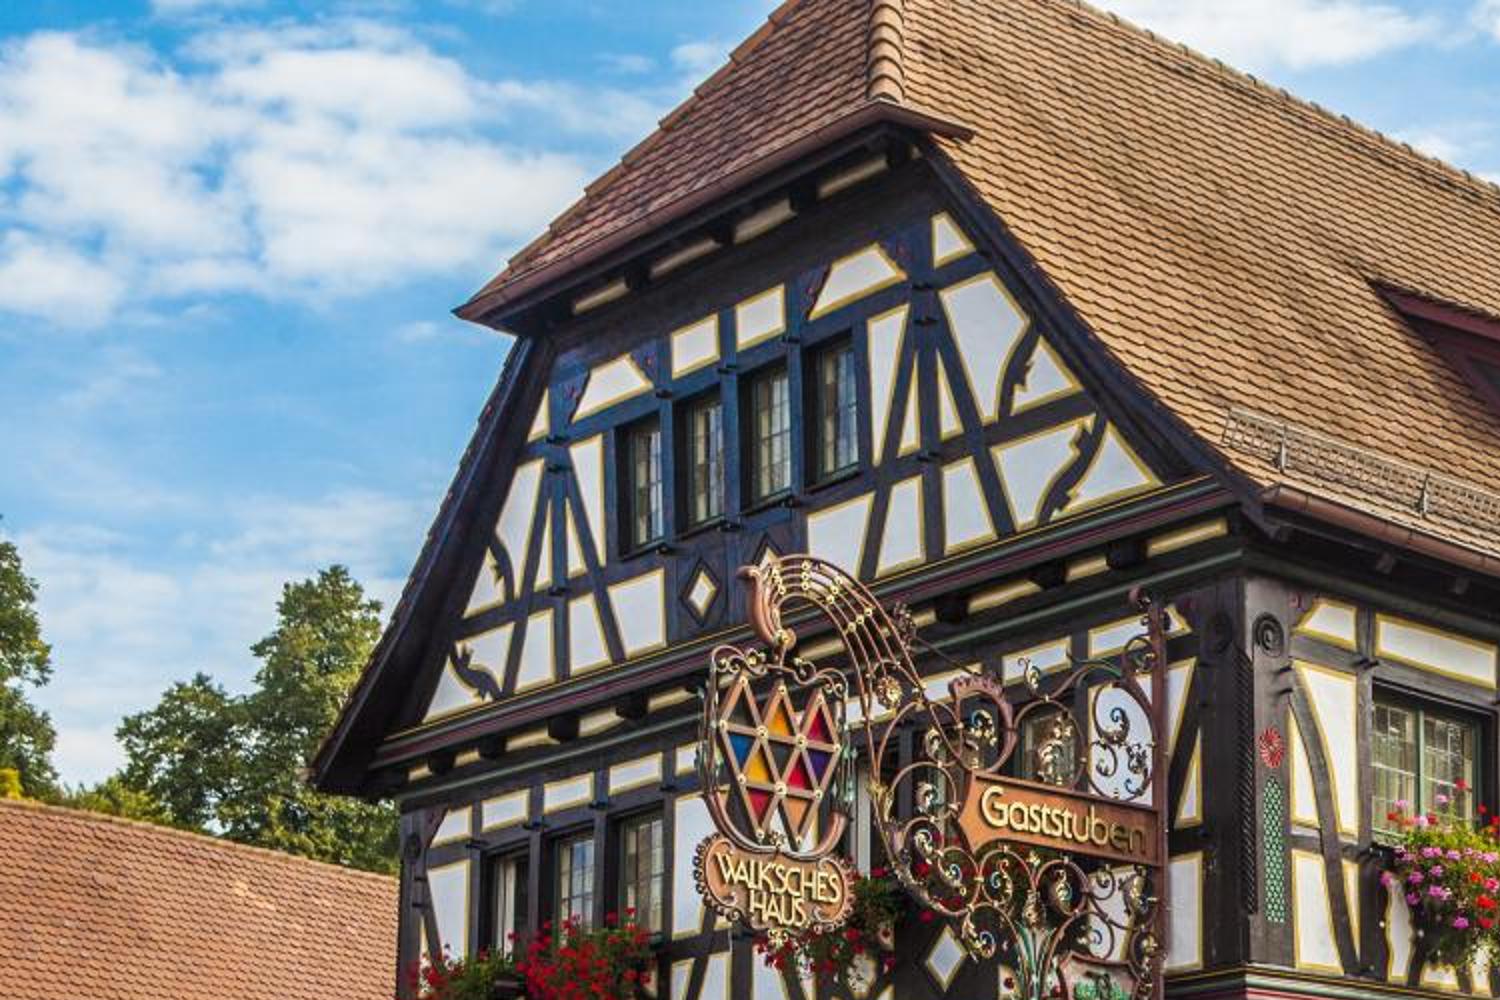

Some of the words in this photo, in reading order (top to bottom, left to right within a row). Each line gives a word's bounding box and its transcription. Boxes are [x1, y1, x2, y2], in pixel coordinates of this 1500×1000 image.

[982, 785, 1147, 853] Gaststuben
[716, 852, 841, 903] WALK'SCHES
[749, 890, 808, 926] HAUS
